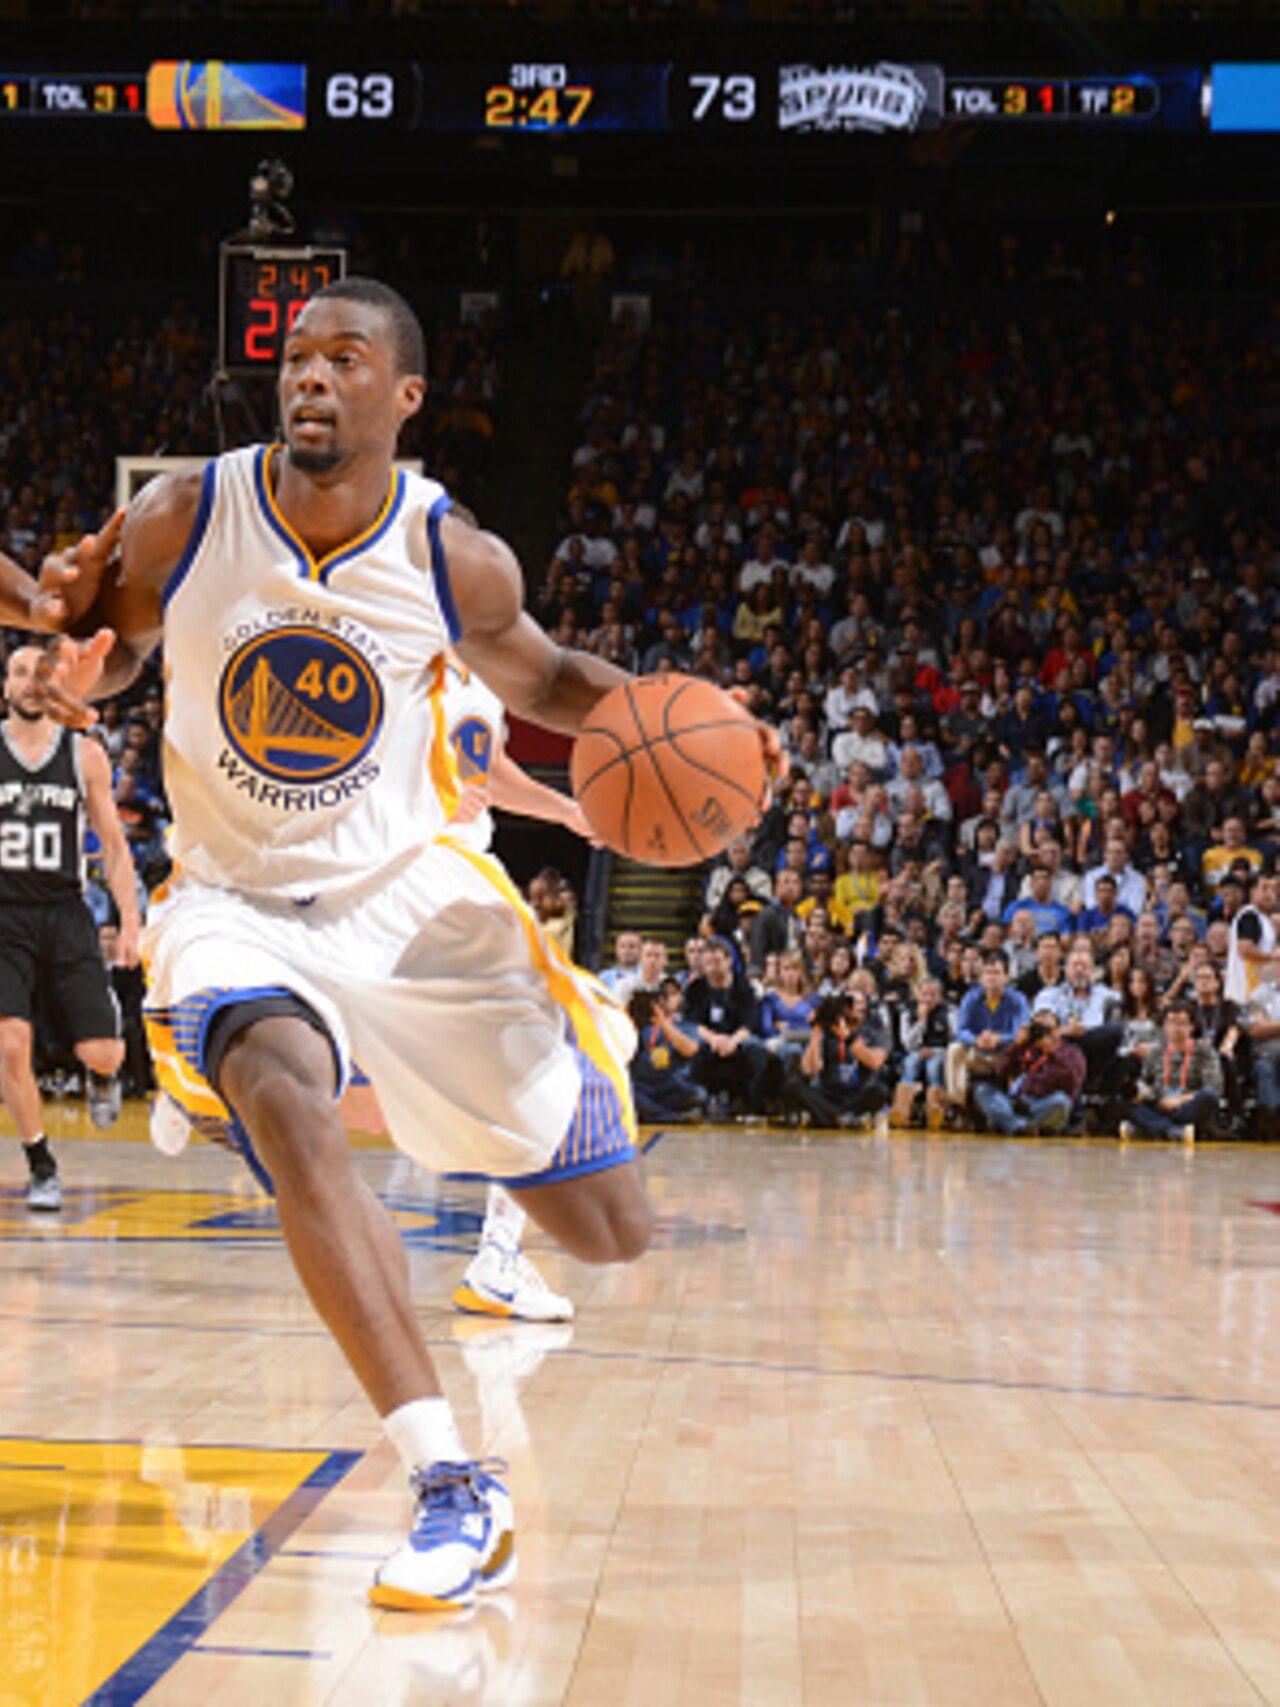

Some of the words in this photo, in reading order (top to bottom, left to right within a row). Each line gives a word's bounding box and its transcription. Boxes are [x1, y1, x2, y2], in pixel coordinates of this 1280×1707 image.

[325, 74, 394, 118] 63
[509, 63, 567, 88] 3RD
[3, 84, 19, 110] 1
[42, 85, 87, 111] TOL
[93, 85, 116, 112] 3
[124, 85, 141, 111] 1
[484, 86, 593, 127] 2:47
[688, 75, 756, 120] 73
[952, 90, 998, 113] TOL
[1004, 88, 1028, 115] 3
[1038, 88, 1054, 114] 1
[1080, 90, 1109, 114] TF
[1111, 89, 1136, 114] 2
[222, 607, 320, 651] GOLDEN
[331, 614, 389, 668] STATE
[294, 658, 359, 704] 40
[217, 748, 381, 812] WARRIORS
